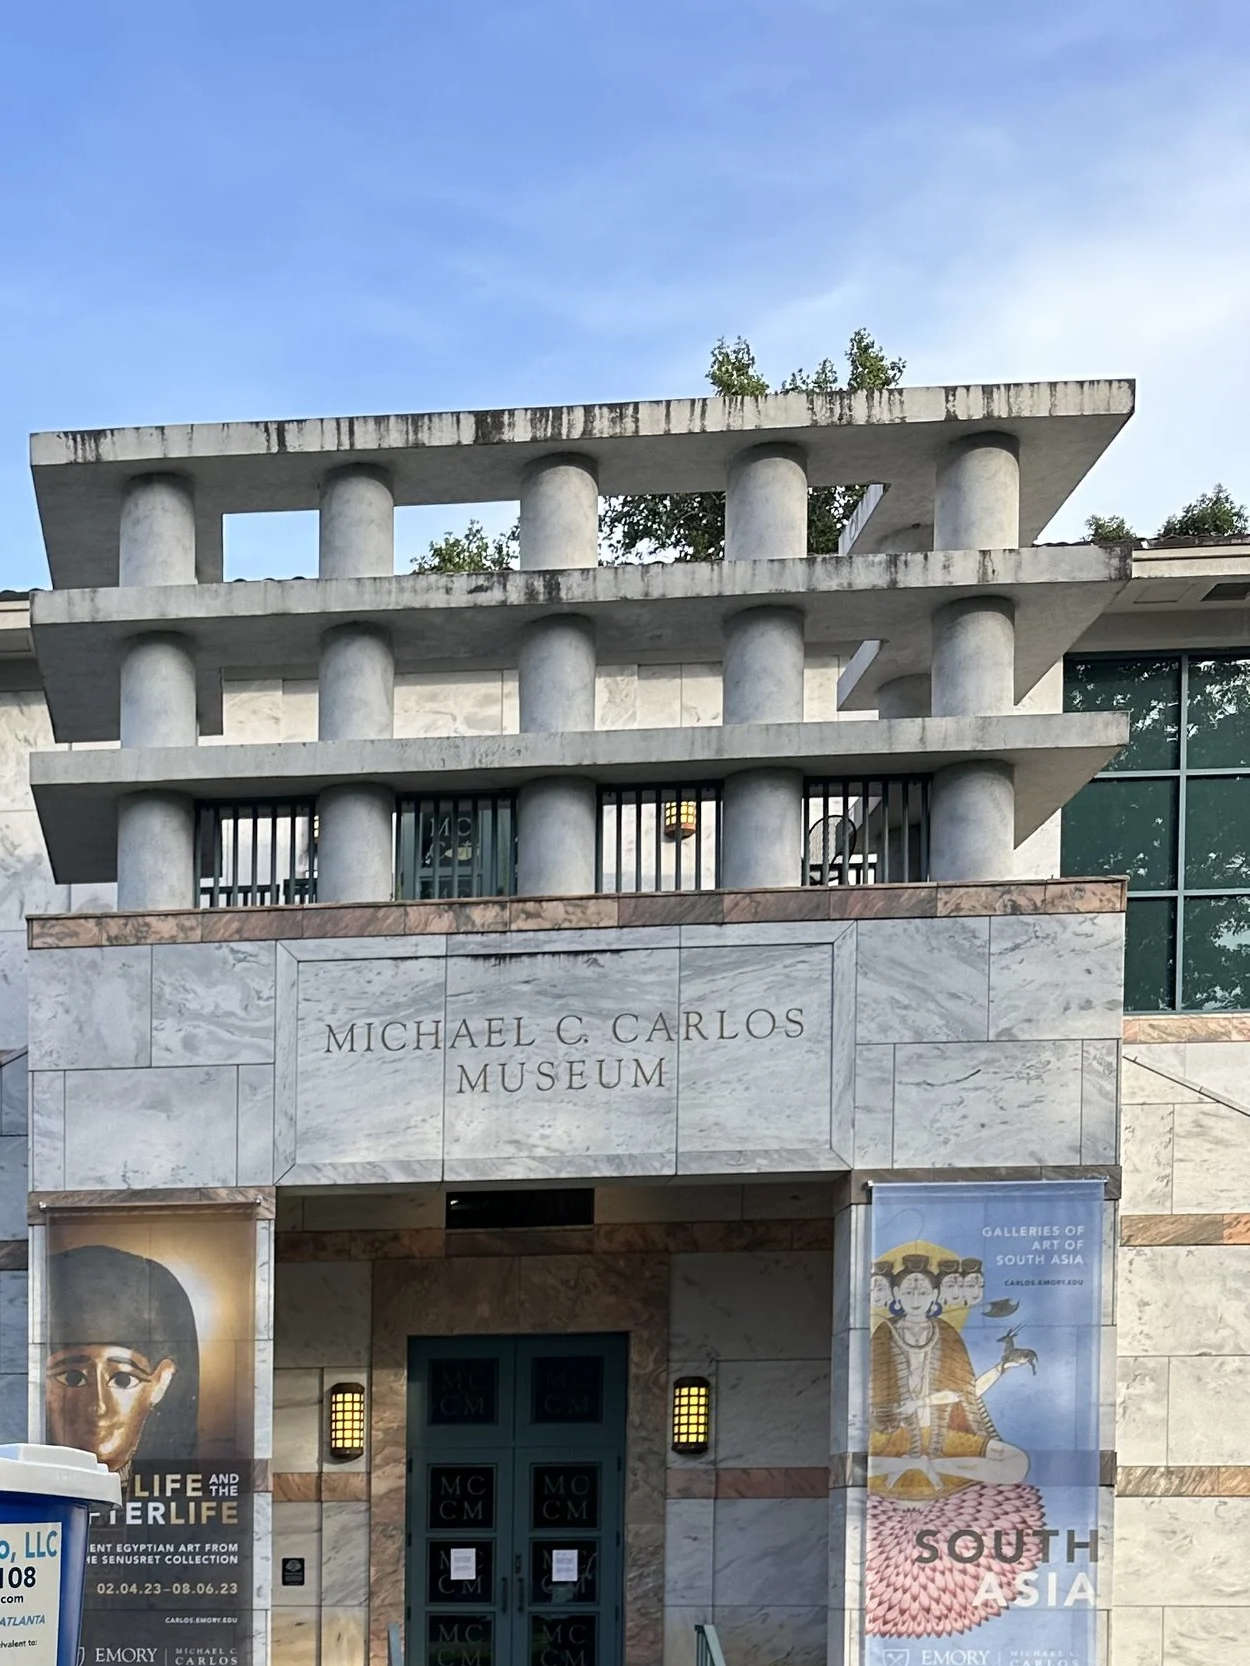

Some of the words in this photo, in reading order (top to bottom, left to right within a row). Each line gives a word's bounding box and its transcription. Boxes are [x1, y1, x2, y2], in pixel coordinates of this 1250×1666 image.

[325, 1016, 536, 1053] MICHAEL
[556, 1015, 589, 1045] C.
[612, 1008, 805, 1043] CARLOS
[457, 1058, 667, 1093] MUSEUM
[982, 1226, 1060, 1237] GALLERIES
[1065, 1226, 1085, 1236] OF
[1032, 1240, 1060, 1250] ART
[1065, 1240, 1084, 1250] OF
[996, 1255, 1045, 1265] SOUTH
[1051, 1254, 1084, 1264] ASIA
[209, 1473, 239, 1484] AND
[135, 1474, 203, 1497] LIFE
[210, 1485, 239, 1496] THE
[25, 1530, 58, 1559] LLC
[89, 1544, 111, 1553] ENT
[116, 1544, 174, 1553] EGYPTIAN
[178, 1544, 202, 1553] ART
[205, 1543, 239, 1553] FROM
[914, 1529, 1098, 1564] SOUTH
[102, 1555, 160, 1564] SENUSRET
[165, 1555, 239, 1564] COLLECTION
[972, 1571, 1096, 1608] ASIA
[95, 1648, 158, 1662] EMORY
[175, 1656, 238, 1666] CARLOS
[921, 1650, 991, 1666] EMORY
